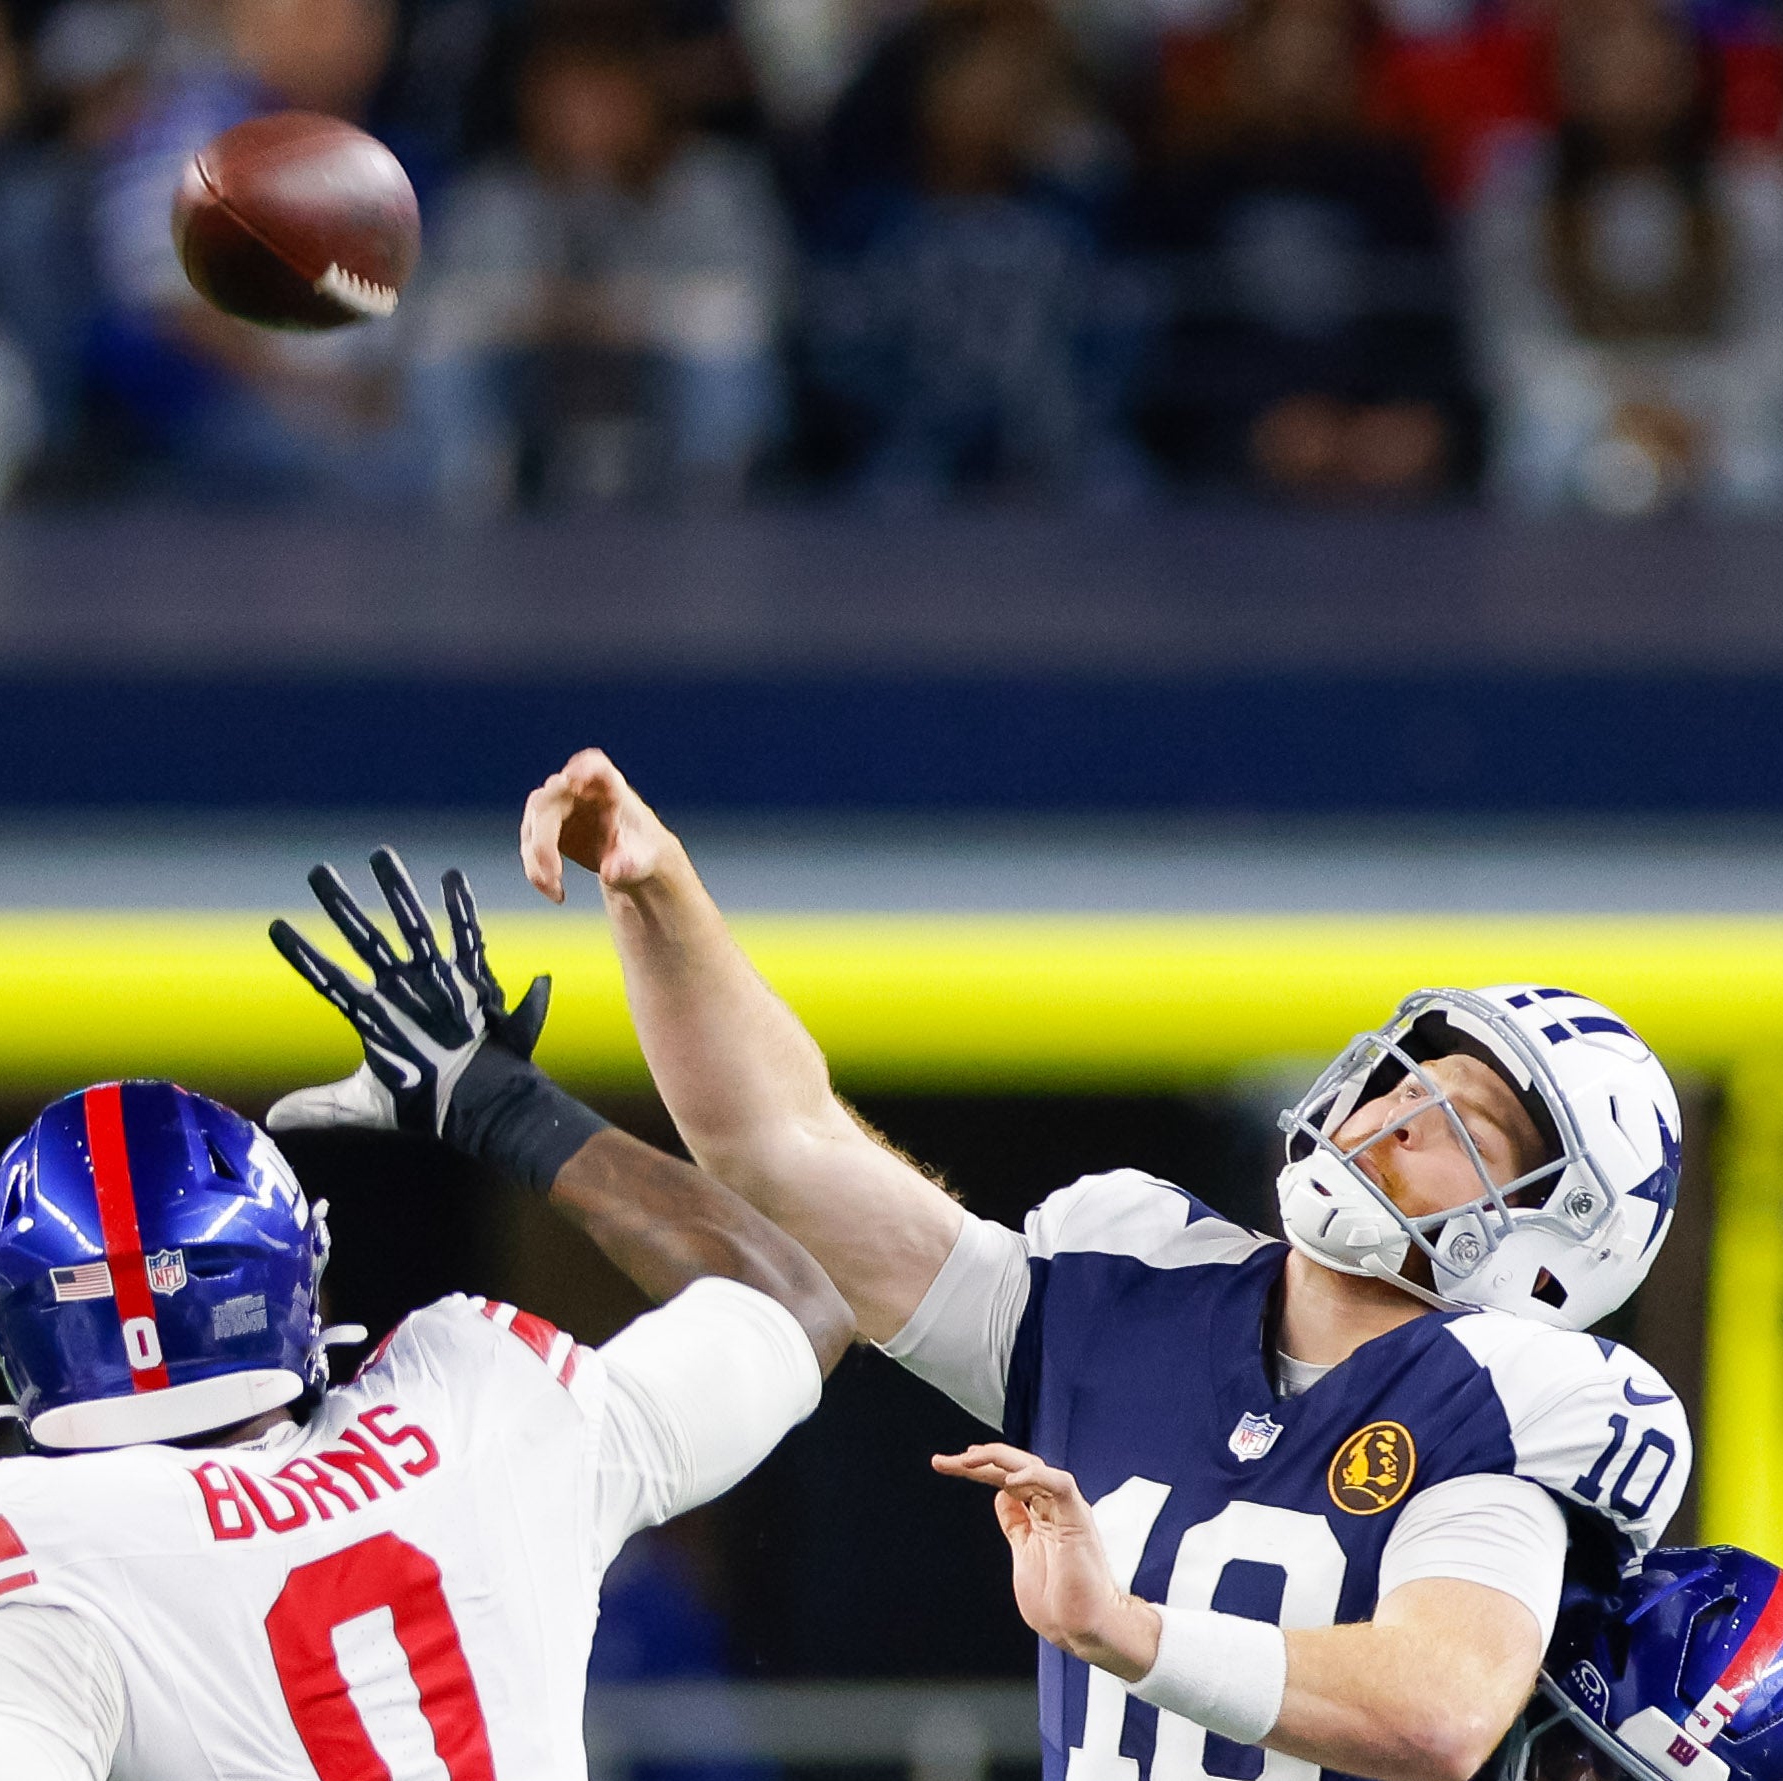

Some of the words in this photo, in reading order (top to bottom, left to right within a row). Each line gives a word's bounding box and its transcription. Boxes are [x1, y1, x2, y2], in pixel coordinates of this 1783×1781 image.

[153, 1265, 182, 1287] NFL
[123, 1316, 163, 1370] 0
[188, 1404, 440, 1542] BURNS
[1571, 1413, 1676, 1520] 10
[1685, 1683, 1741, 1743] 5
